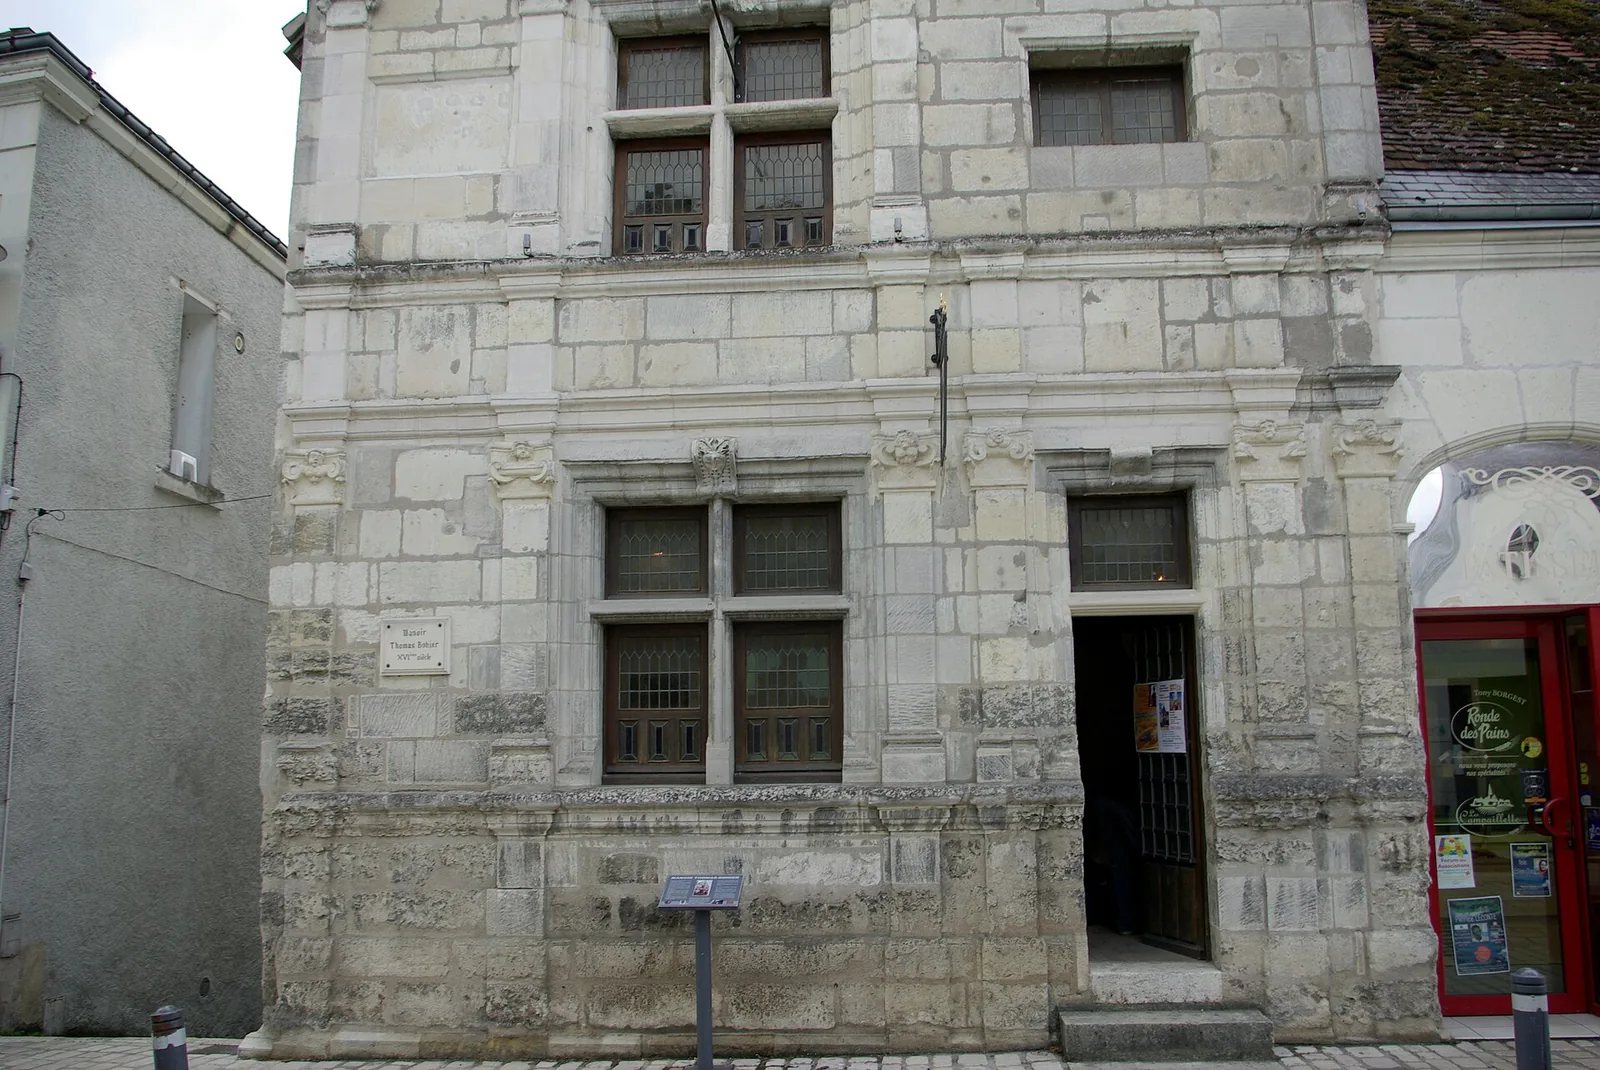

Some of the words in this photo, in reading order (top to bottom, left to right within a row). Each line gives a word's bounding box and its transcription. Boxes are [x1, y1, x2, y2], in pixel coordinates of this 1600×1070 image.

[389, 641, 415, 649] Thomas
[417, 641, 439, 649] Bohier
[1473, 689, 1491, 698] Tony
[1492, 690, 1527, 705] BORGEST
[1467, 706, 1500, 727] Ronde
[1460, 725, 1479, 739] des
[1478, 722, 1510, 744] Pains
[1488, 762, 1517, 771] proposons
